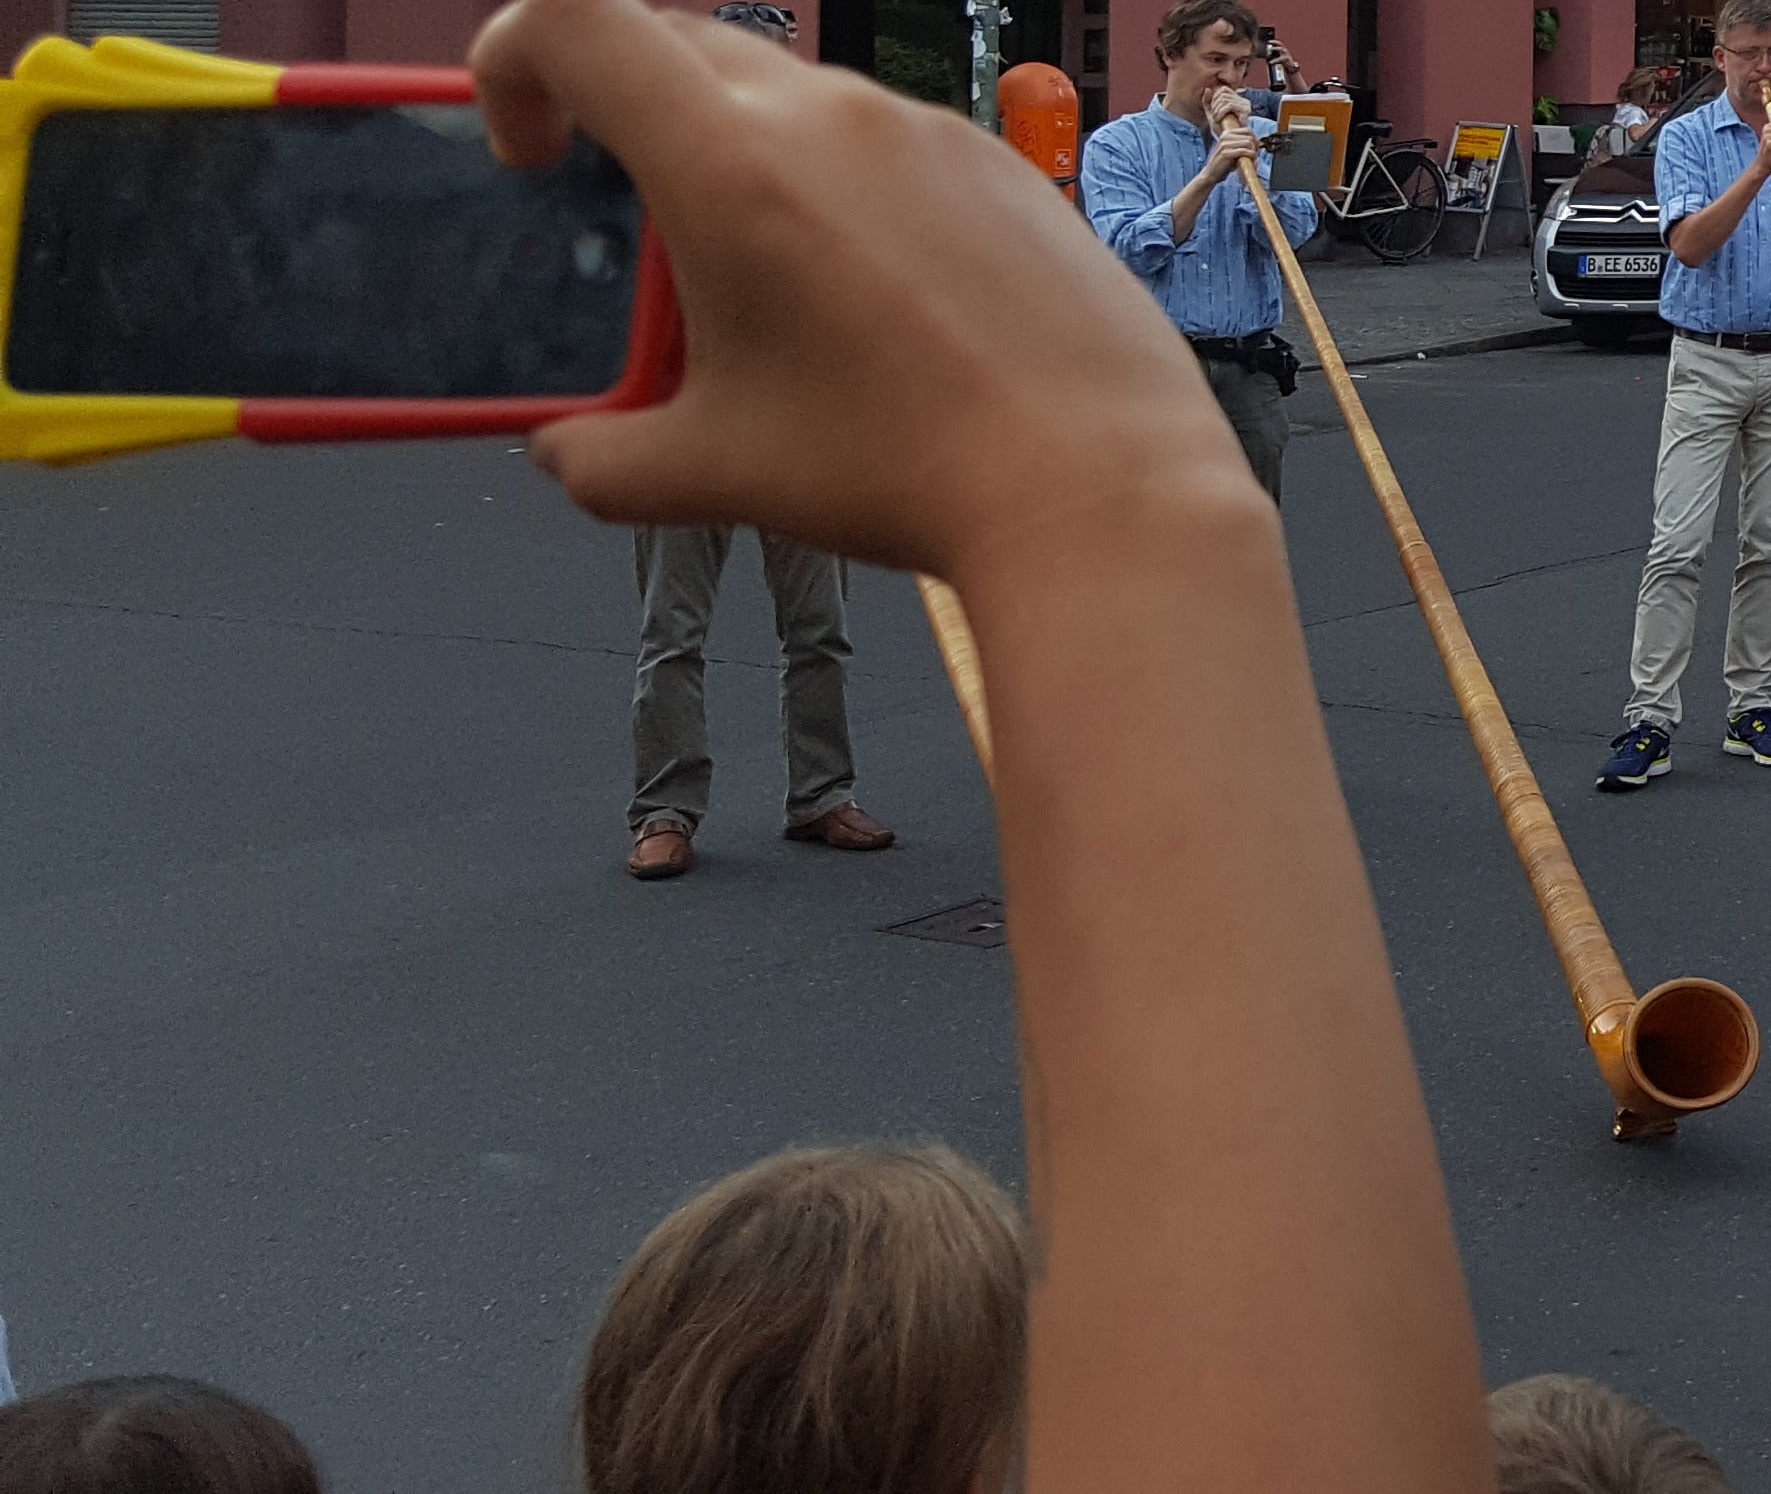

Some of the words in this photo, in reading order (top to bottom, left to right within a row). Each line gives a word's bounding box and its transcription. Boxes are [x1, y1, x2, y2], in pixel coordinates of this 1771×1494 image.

[1588, 256, 1596, 272] B
[1604, 256, 1622, 272] EE
[1624, 256, 1658, 273] 6536
